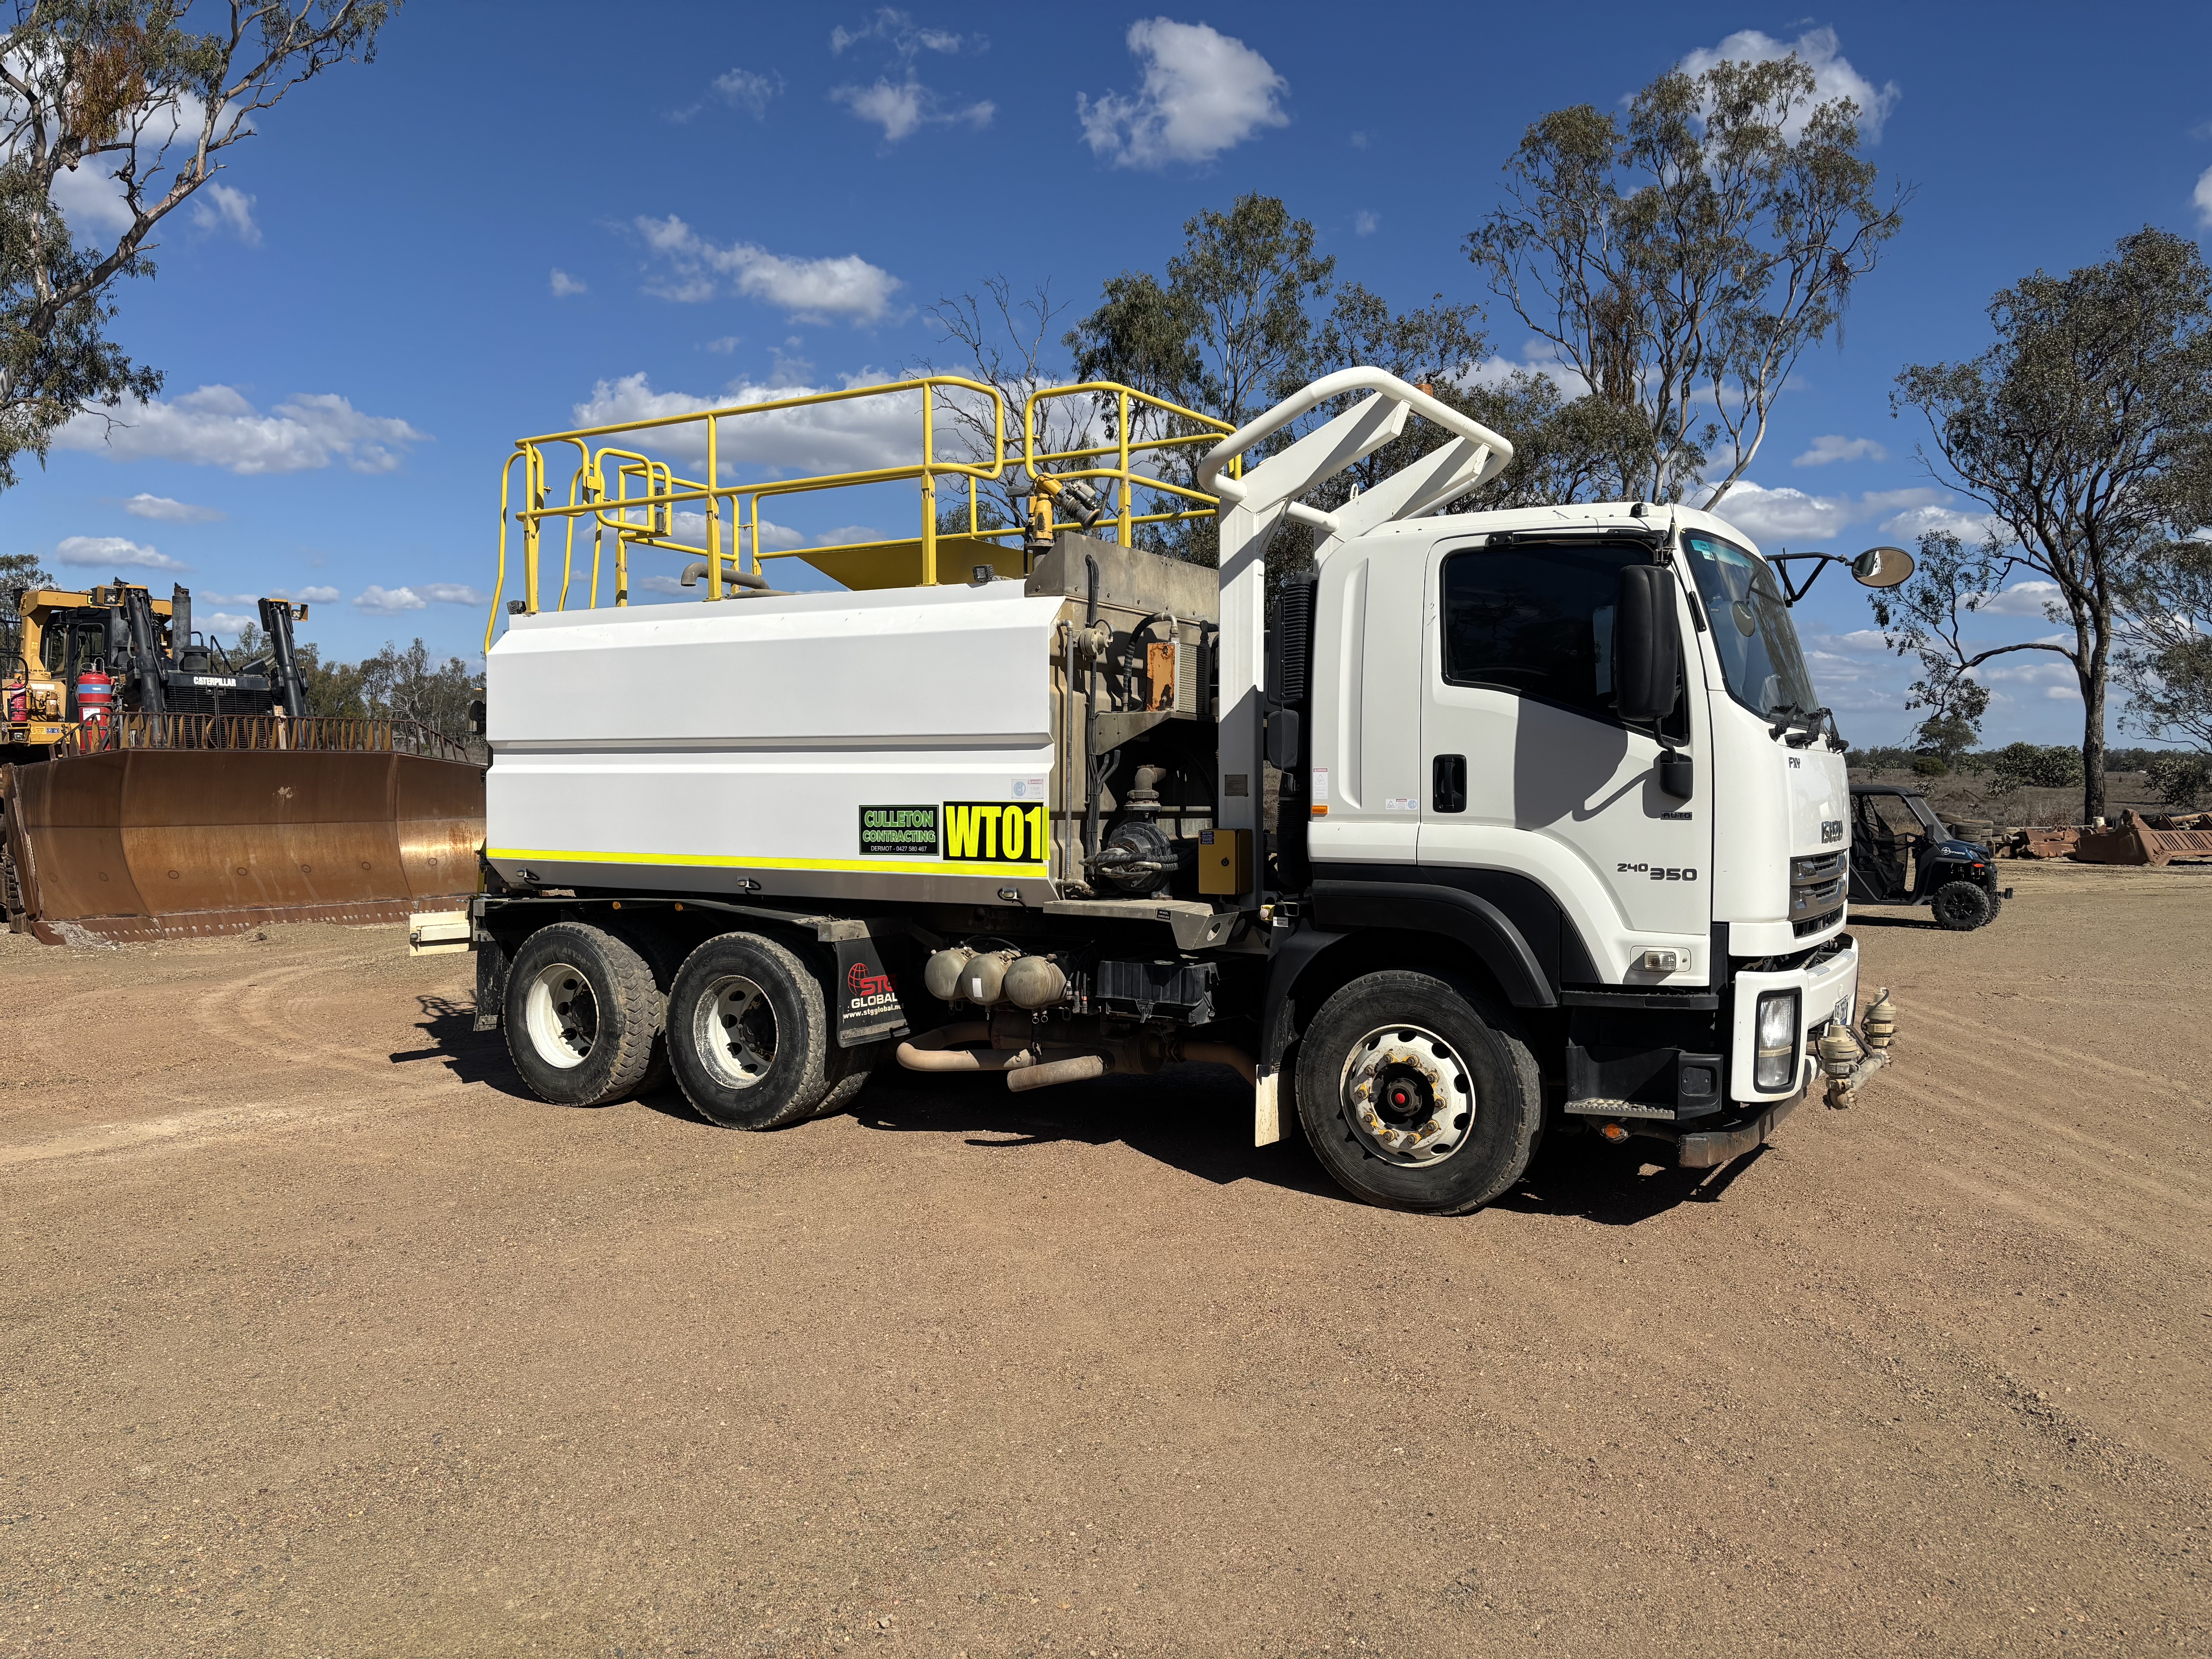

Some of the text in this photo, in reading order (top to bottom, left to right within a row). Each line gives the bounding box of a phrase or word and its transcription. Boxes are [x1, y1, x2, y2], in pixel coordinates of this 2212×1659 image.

[194, 677, 236, 687] CATERPILLAR
[1788, 757, 1800, 768] FXY
[864, 810, 933, 827] CULLETON
[862, 830, 936, 842] CONTRACTING
[946, 805, 1042, 859] WT01
[1617, 863, 1697, 881] 240 350
[860, 973, 897, 996] STG
[851, 993, 898, 1009] GLOBAL
